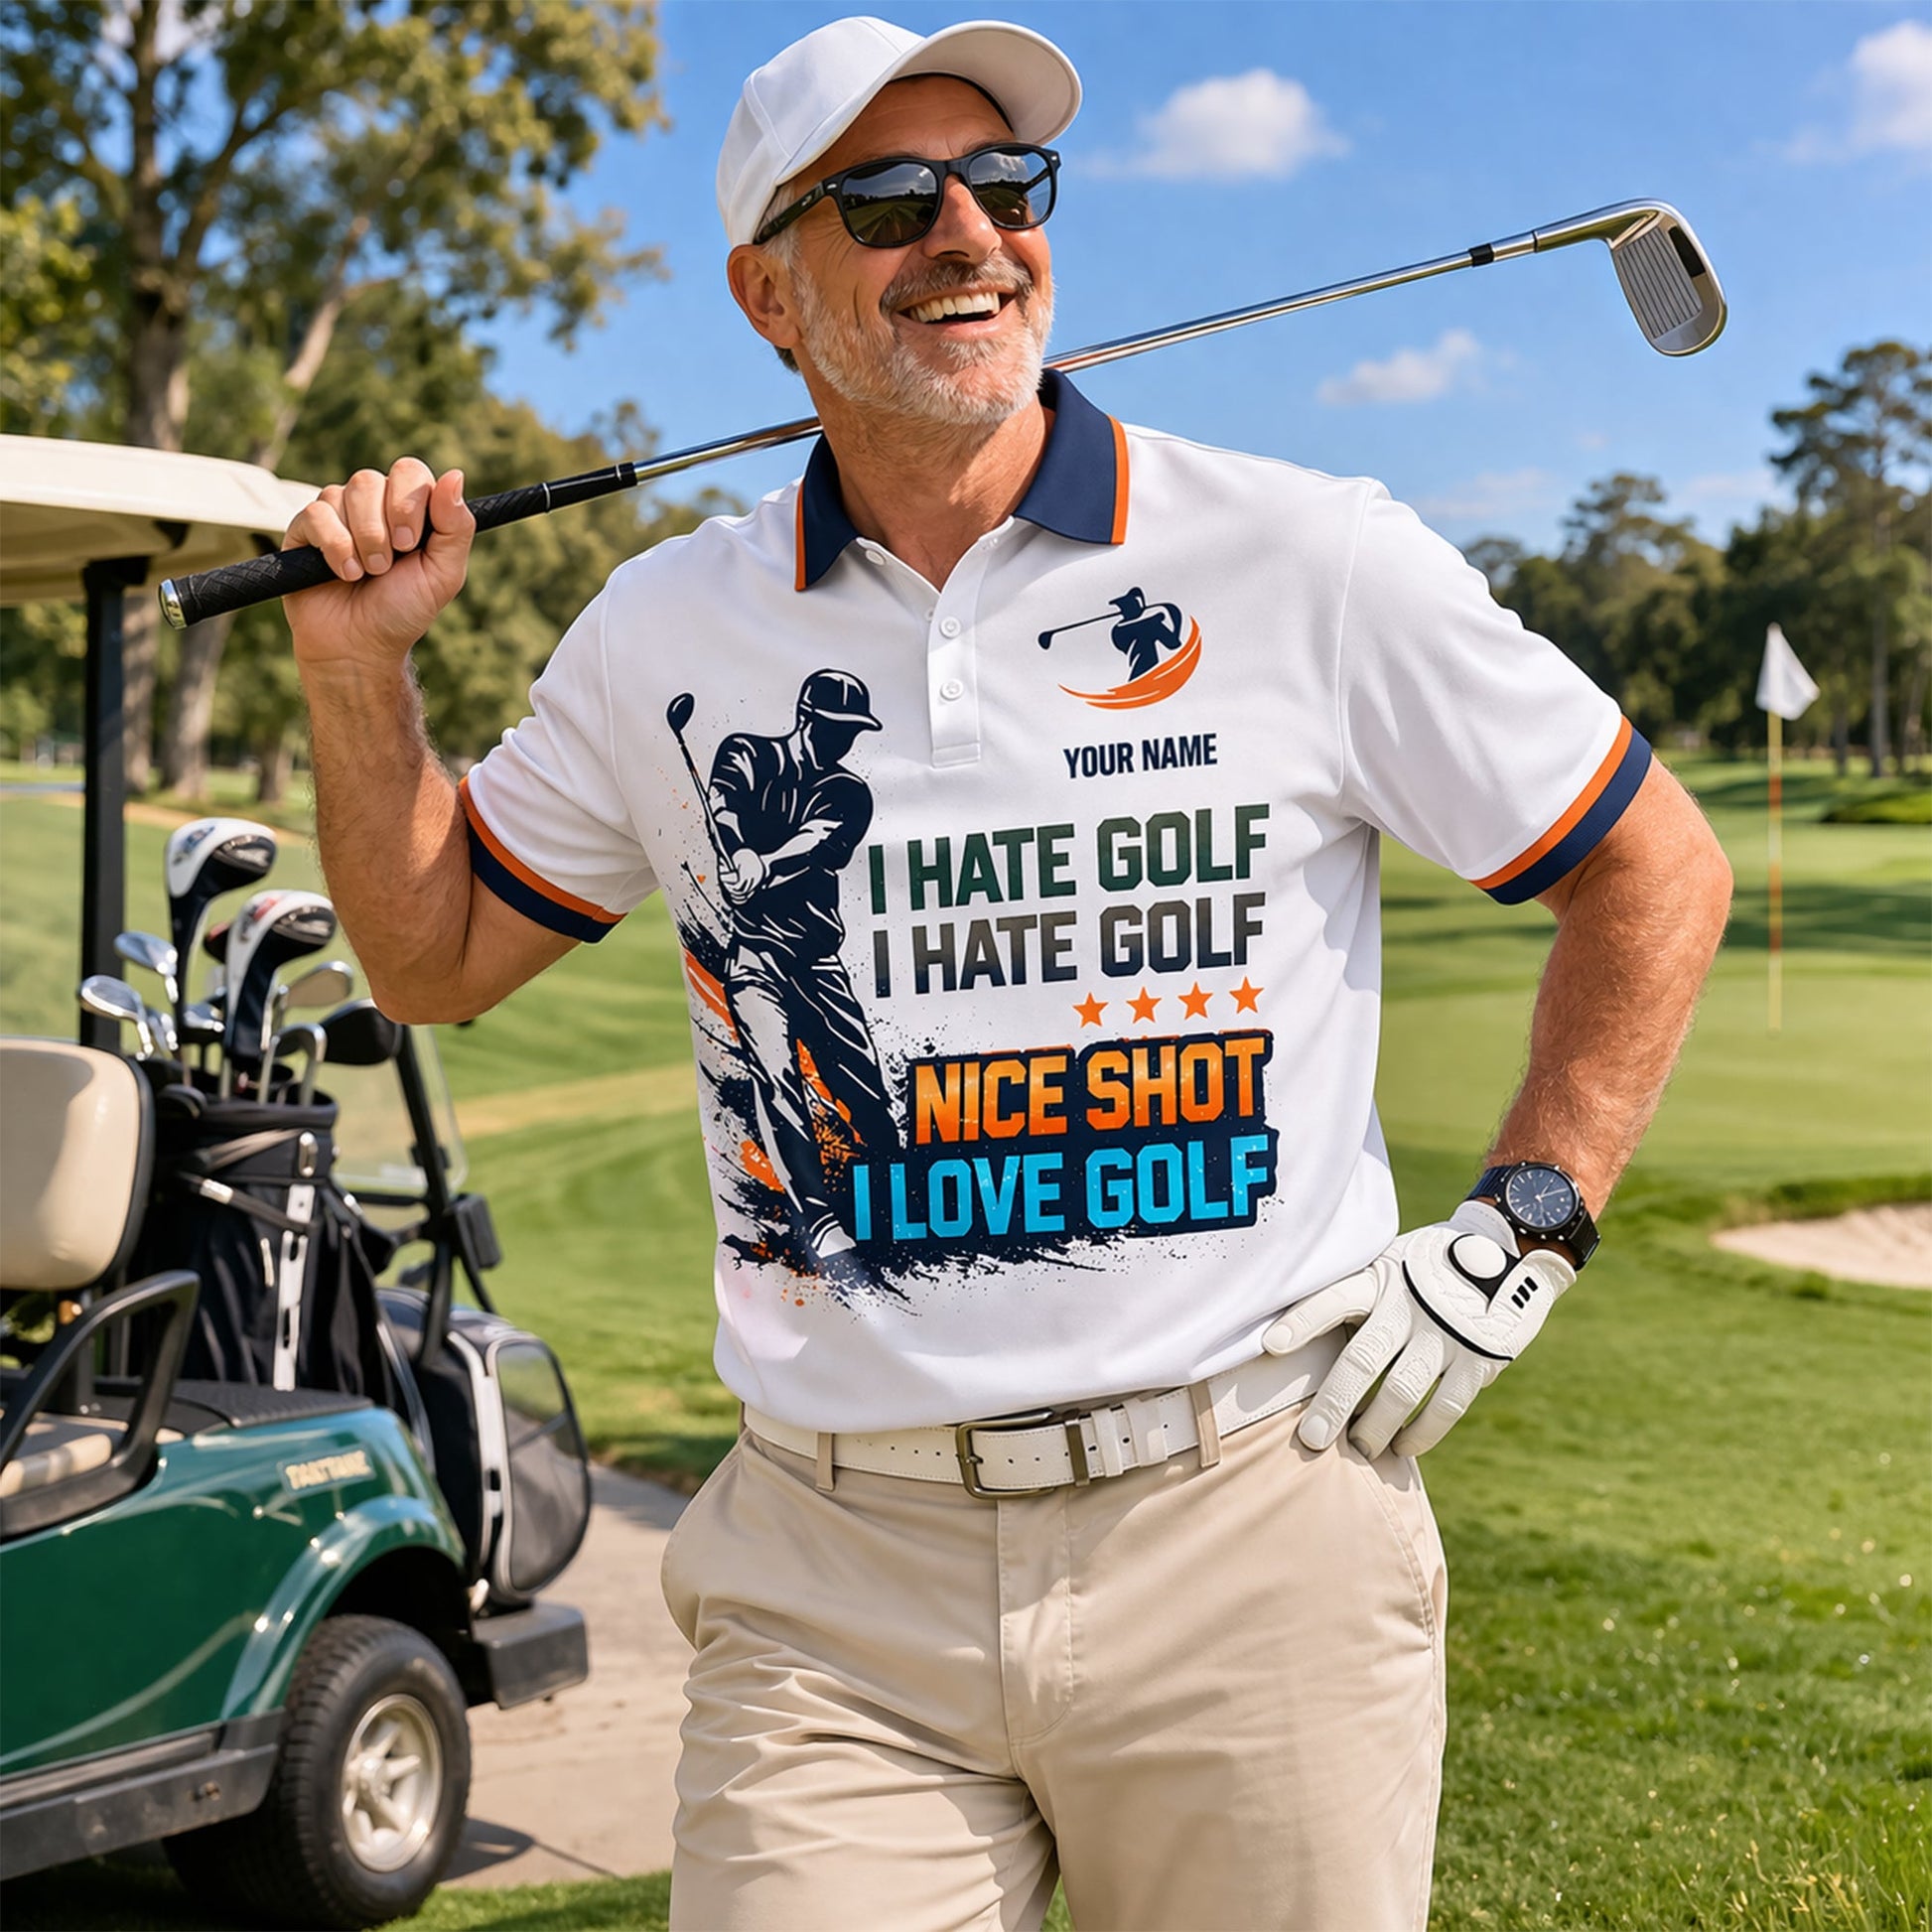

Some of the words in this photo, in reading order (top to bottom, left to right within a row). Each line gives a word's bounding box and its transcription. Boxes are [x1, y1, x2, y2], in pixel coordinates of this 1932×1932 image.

[1063, 740, 1134, 779] YOUR
[1142, 733, 1217, 770] NAME
[869, 844, 887, 914] I
[907, 823, 1077, 911] HATE
[1096, 803, 1270, 893] GOLF
[873, 929, 892, 998] I
[911, 910, 1077, 994] HATE
[1099, 892, 1266, 978] GOLF
[914, 1054, 1067, 1145] NICE
[1085, 1037, 1265, 1131] SHOT
[853, 1165, 872, 1241] I
[890, 1153, 1065, 1241] LOVE
[1085, 1134, 1269, 1229] GOLF
